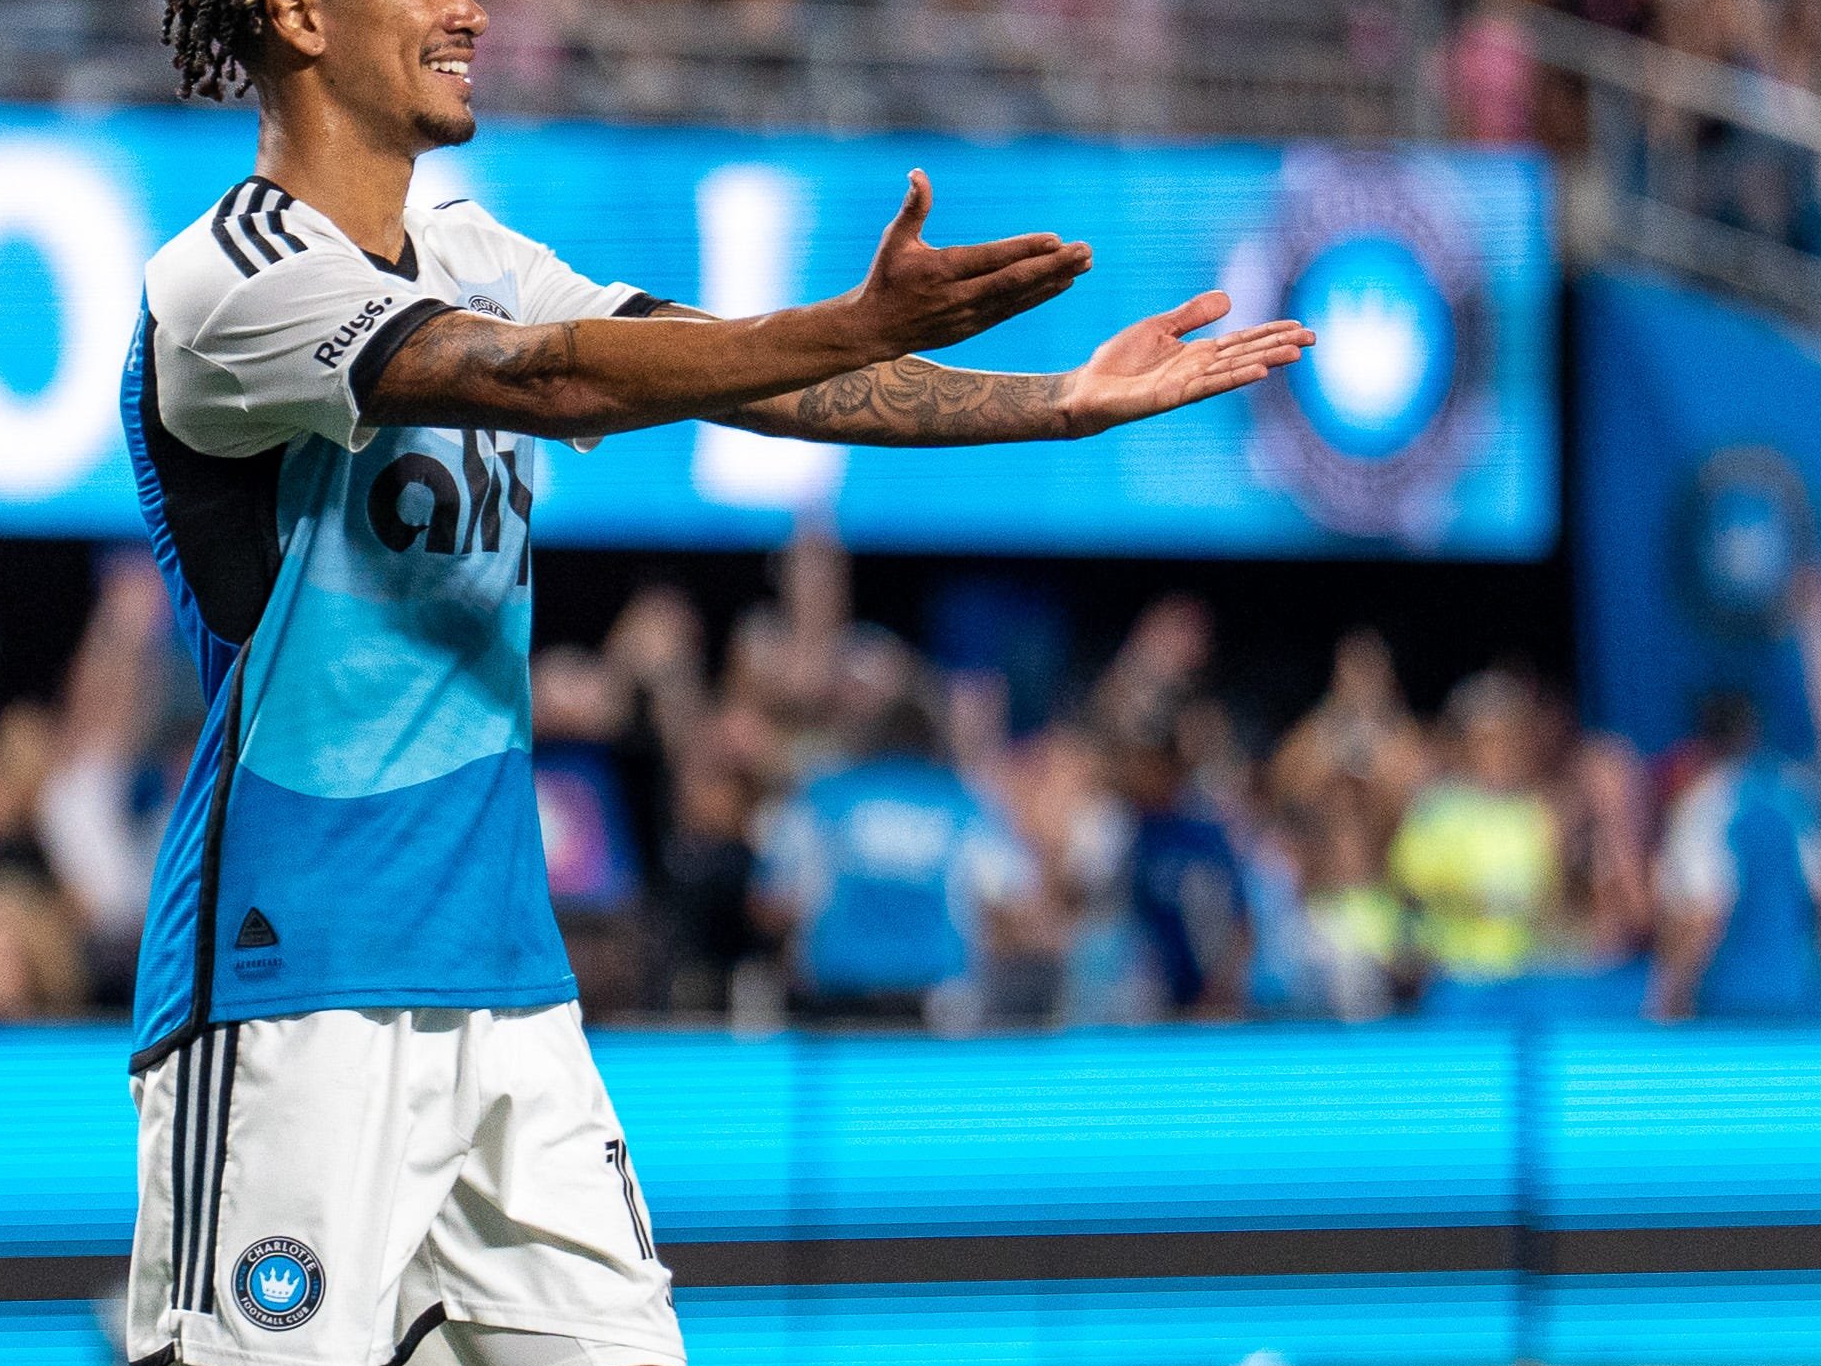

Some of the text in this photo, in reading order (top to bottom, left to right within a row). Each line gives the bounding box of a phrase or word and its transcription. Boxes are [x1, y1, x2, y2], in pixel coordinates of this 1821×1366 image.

[313, 296, 393, 369] Rugs.
[246, 1241, 317, 1272] CHARLOTTE
[240, 1296, 310, 1325] FOOTBALL CLUB
